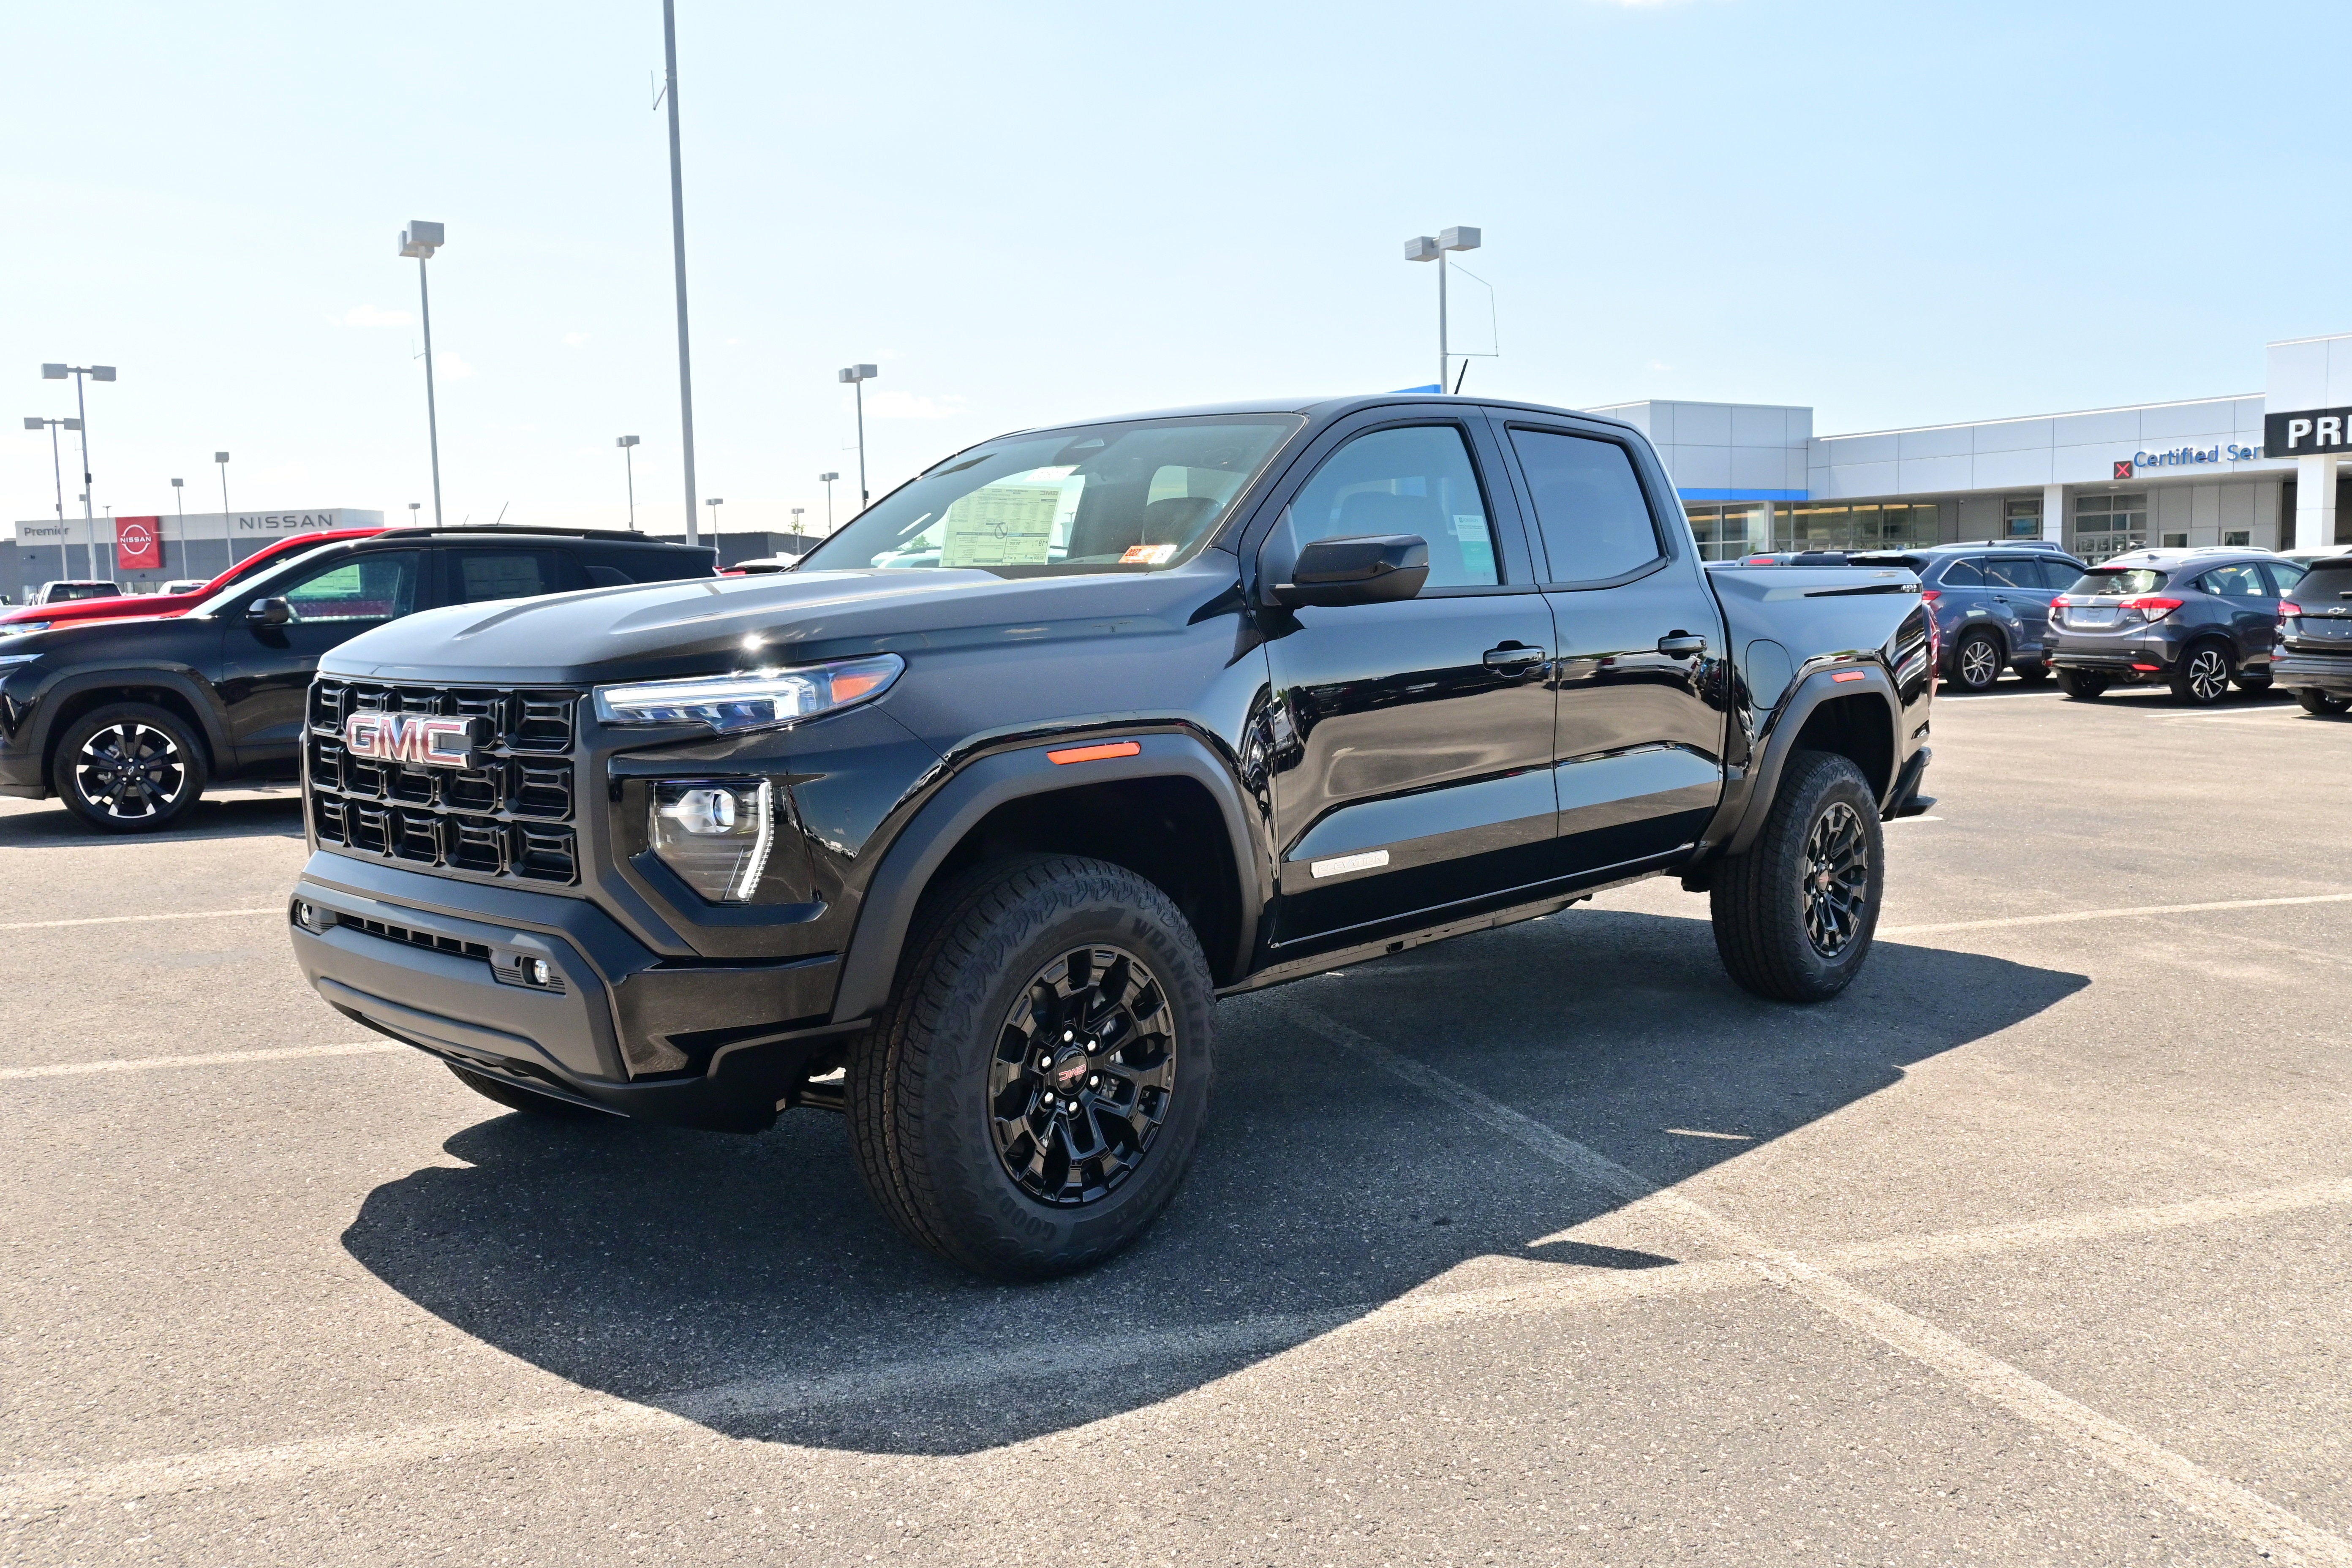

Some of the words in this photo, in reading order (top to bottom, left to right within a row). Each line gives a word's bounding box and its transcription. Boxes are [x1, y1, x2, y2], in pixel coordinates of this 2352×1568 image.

[2288, 414, 2352, 448] PR
[2134, 445, 2219, 467] Certified
[240, 514, 332, 529] NISSAN
[346, 713, 470, 768] GMC
[1318, 855, 1383, 873] ELEVATION
[1130, 916, 1204, 1059] WRANGLER
[1059, 1064, 1086, 1081] GMC
